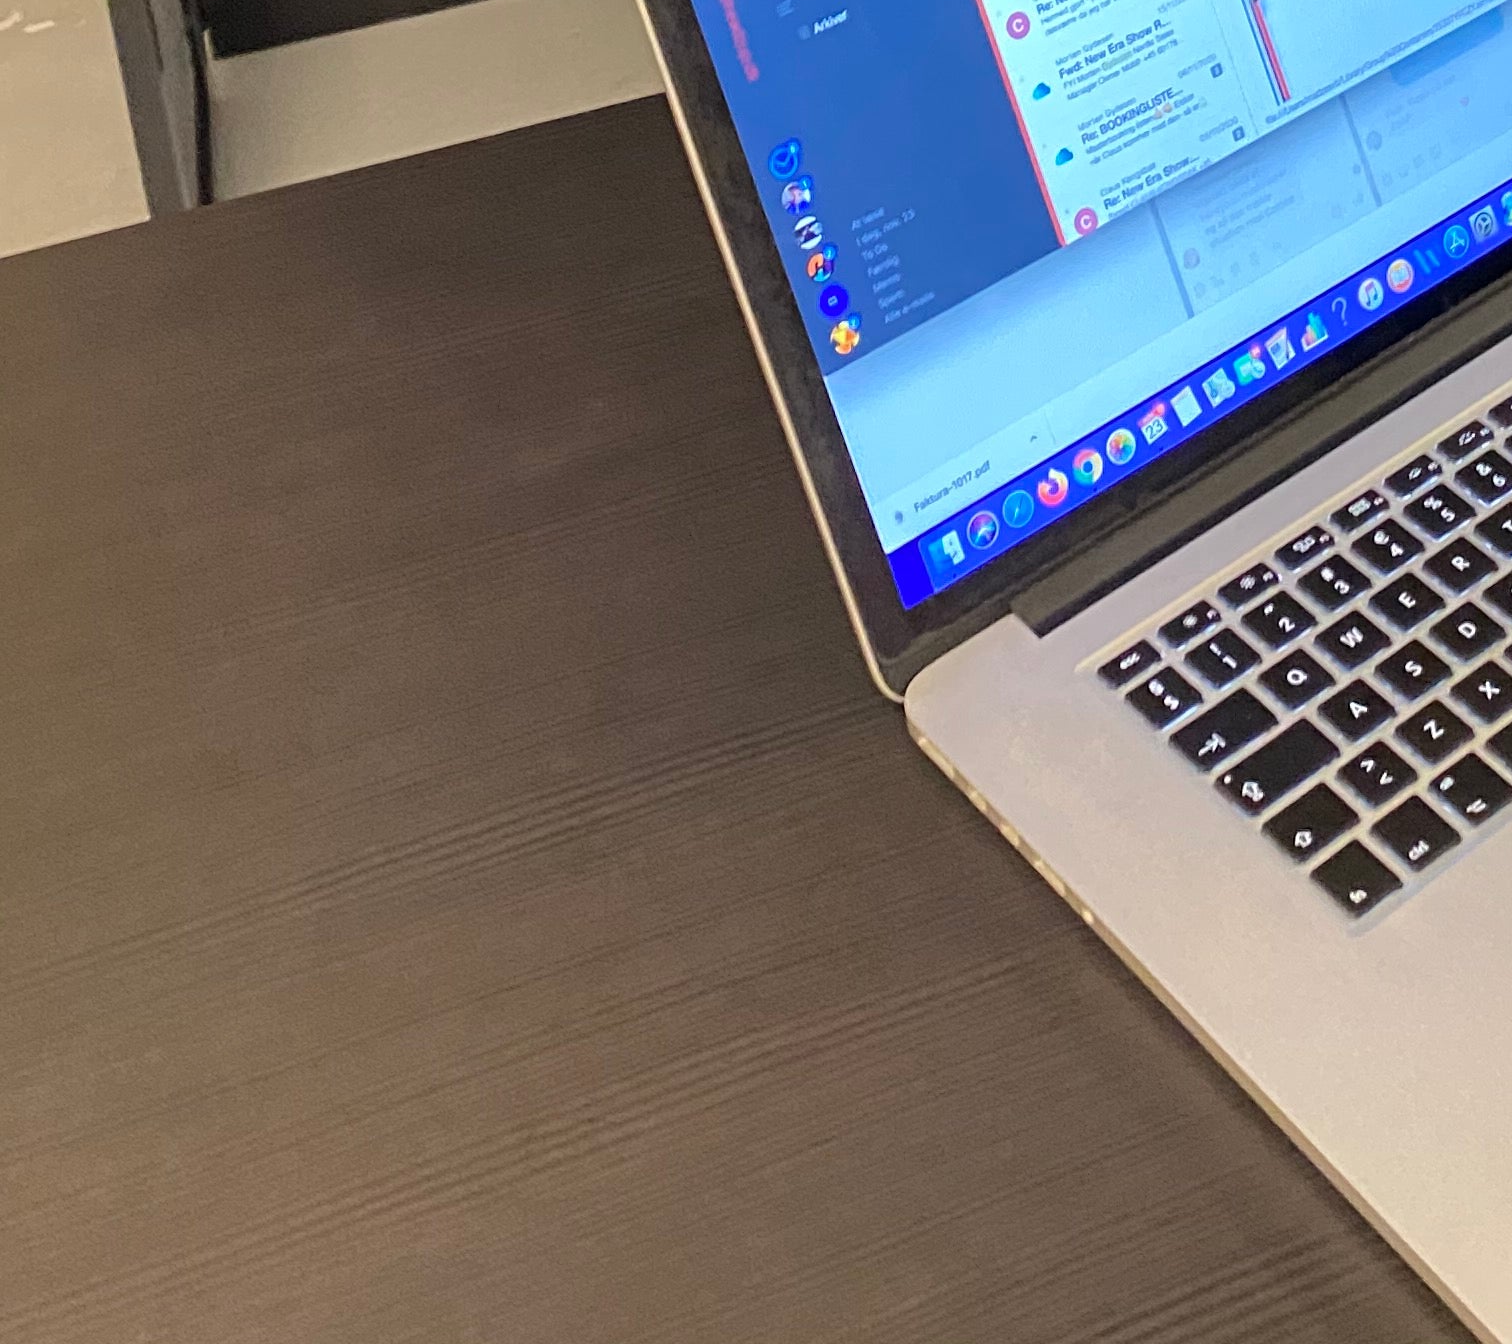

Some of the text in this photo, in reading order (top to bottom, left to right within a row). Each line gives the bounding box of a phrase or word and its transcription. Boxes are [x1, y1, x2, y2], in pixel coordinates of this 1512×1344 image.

[811, 8, 850, 34] Arkiver
[1010, 17, 1025, 34] C
[1058, 59, 1083, 79] Fwd:
[1083, 47, 1107, 66] New
[1107, 38, 1125, 55] Era
[1125, 23, 1153, 45] Show
[1080, 127, 1099, 144] Re:
[1103, 192, 1121, 210] Re:
[1120, 179, 1145, 200] New
[1144, 169, 1162, 187] Era
[1078, 213, 1093, 231] C
[1143, 417, 1165, 441] 23
[912, 459, 991, 515] Faktura-1017.pdf
[1492, 473, 1506, 488] 6
[1441, 507, 1456, 523] 5
[1389, 542, 1404, 557] 4
[1451, 555, 1471, 572] R
[1334, 580, 1350, 595] 3
[1398, 591, 1417, 609] E
[1278, 617, 1296, 632] 2
[1457, 620, 1477, 639] D
[1339, 626, 1364, 649] W
[1223, 656, 1237, 669] 1
[1404, 660, 1423, 677] S
[1286, 668, 1308, 686] Q
[1478, 680, 1501, 701] X
[1349, 700, 1368, 719] A
[1423, 719, 1445, 740] Z
